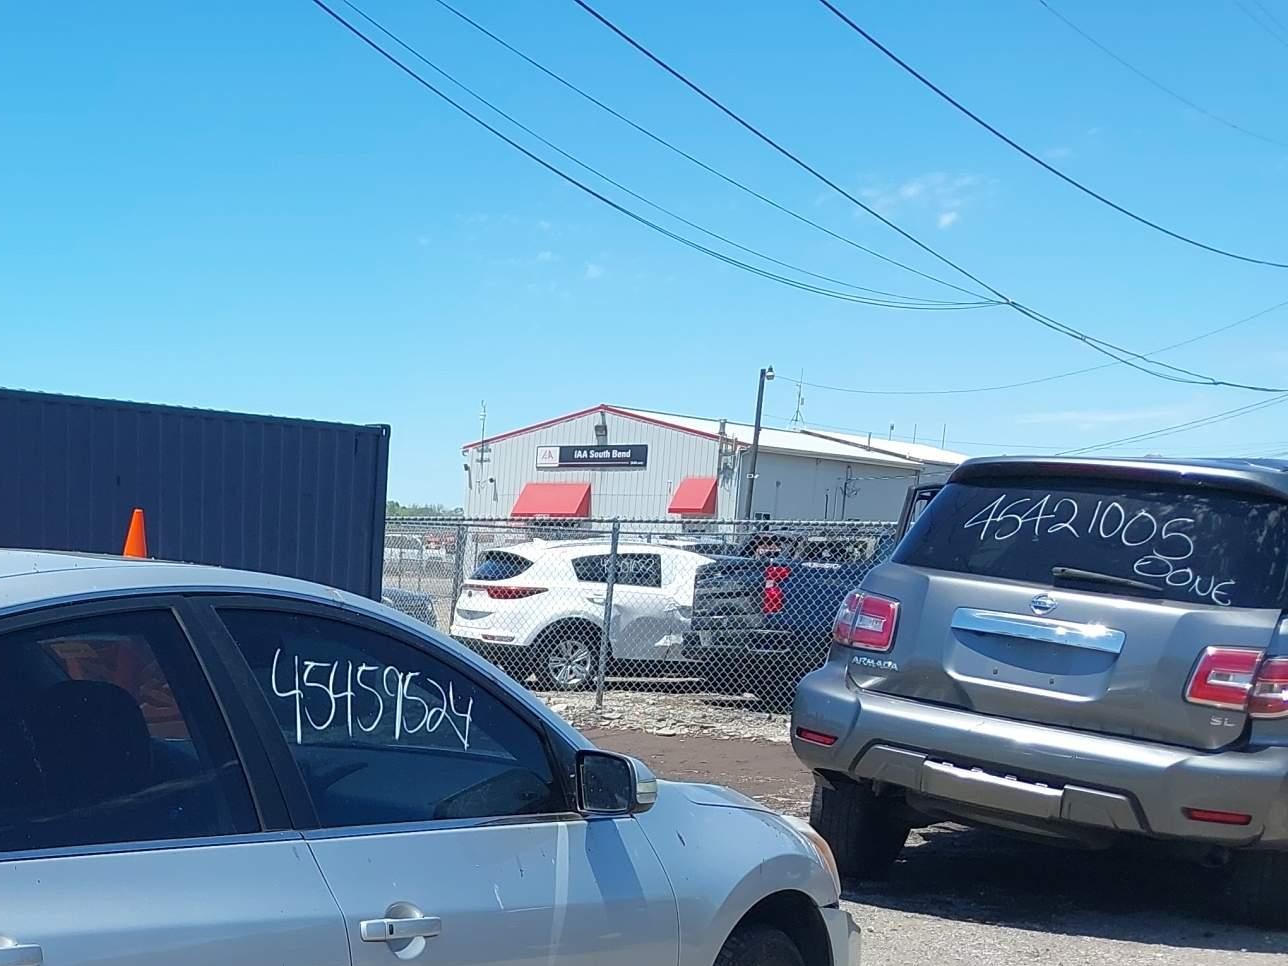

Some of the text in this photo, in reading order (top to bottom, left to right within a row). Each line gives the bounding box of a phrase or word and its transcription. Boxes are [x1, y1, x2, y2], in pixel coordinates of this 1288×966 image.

[574, 448, 631, 459] IAA South Bend
[963, 493, 1195, 561] 45421005
[851, 655, 899, 671] ARMADA
[271, 648, 474, 752] 45459524
[1209, 716, 1236, 727] SL
